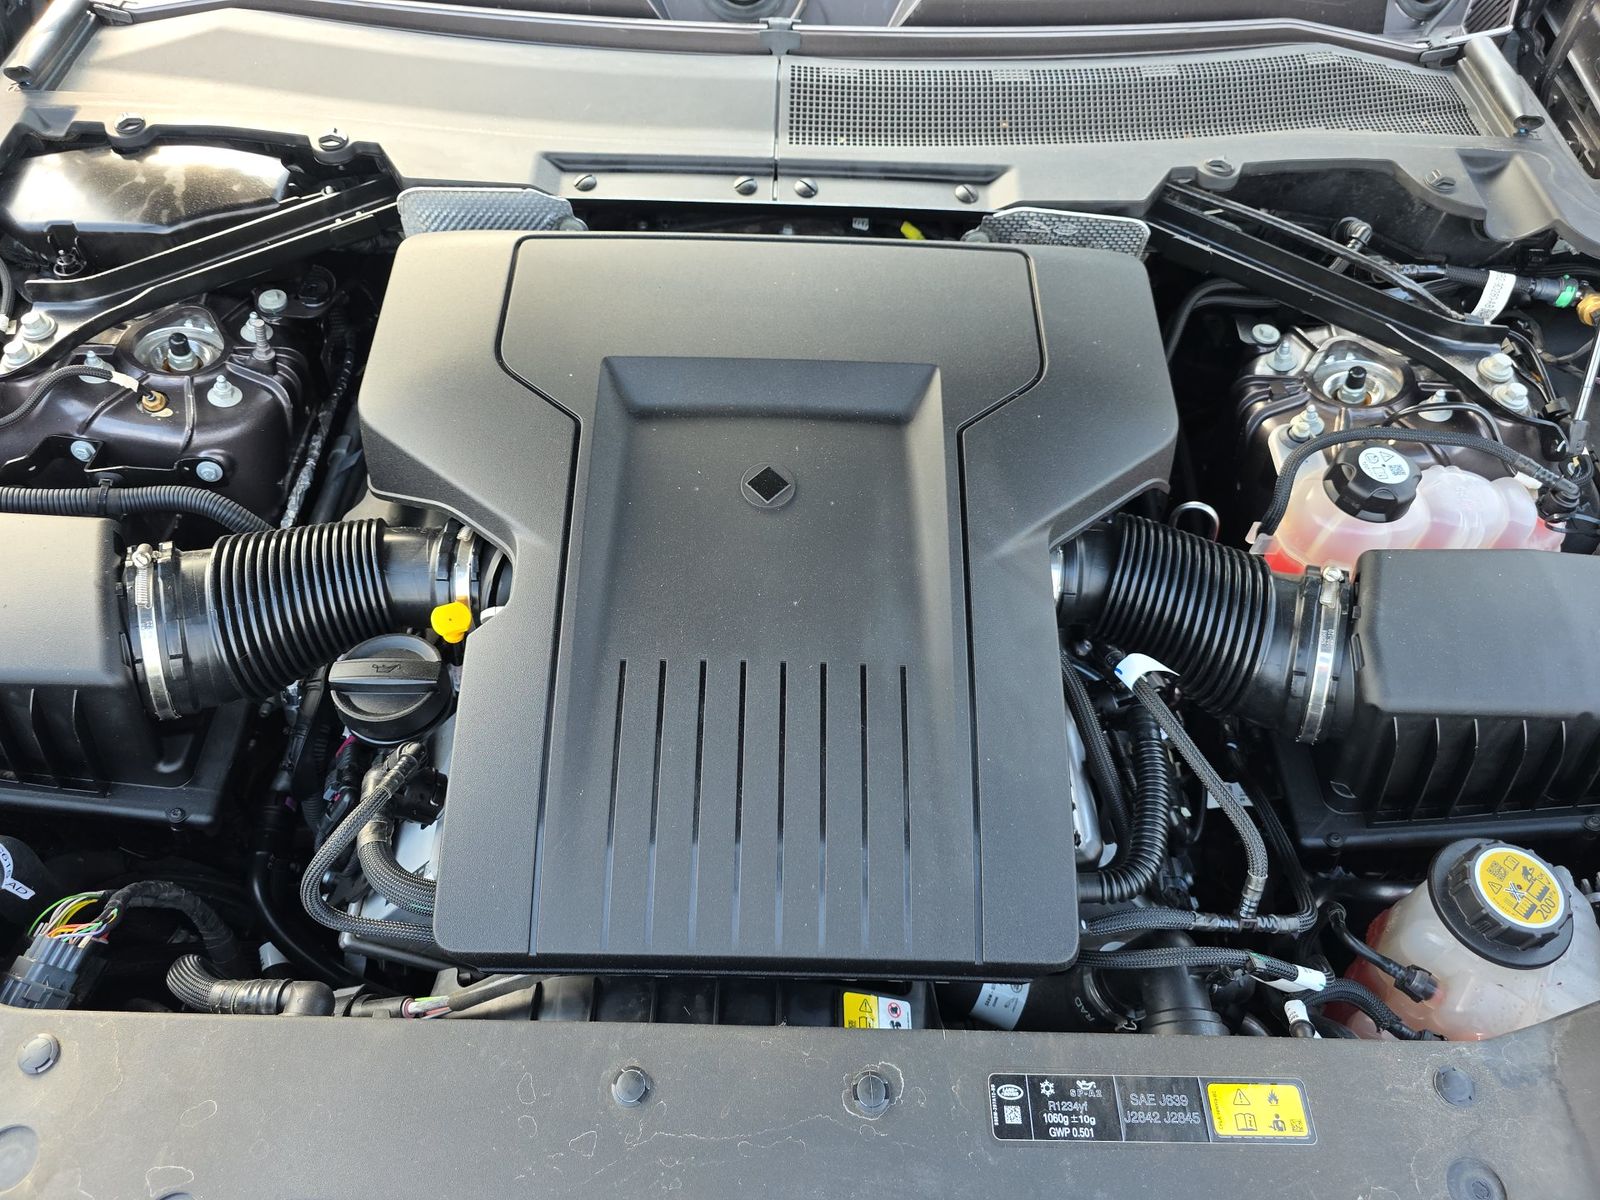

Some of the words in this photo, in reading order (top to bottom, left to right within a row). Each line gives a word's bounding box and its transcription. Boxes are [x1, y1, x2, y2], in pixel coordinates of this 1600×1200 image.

[1129, 1093, 1156, 1106] SAE
[1159, 1094, 1189, 1107] J639
[1048, 1101, 1088, 1114] R1234yf
[1043, 1113, 1069, 1126] 1060g
[1070, 1114, 1096, 1126] ±10g
[1124, 1111, 1161, 1124] J2842
[1163, 1111, 1201, 1124] J2845
[1048, 1127, 1070, 1138] GWP
[1073, 1127, 1094, 1138] 0.501
